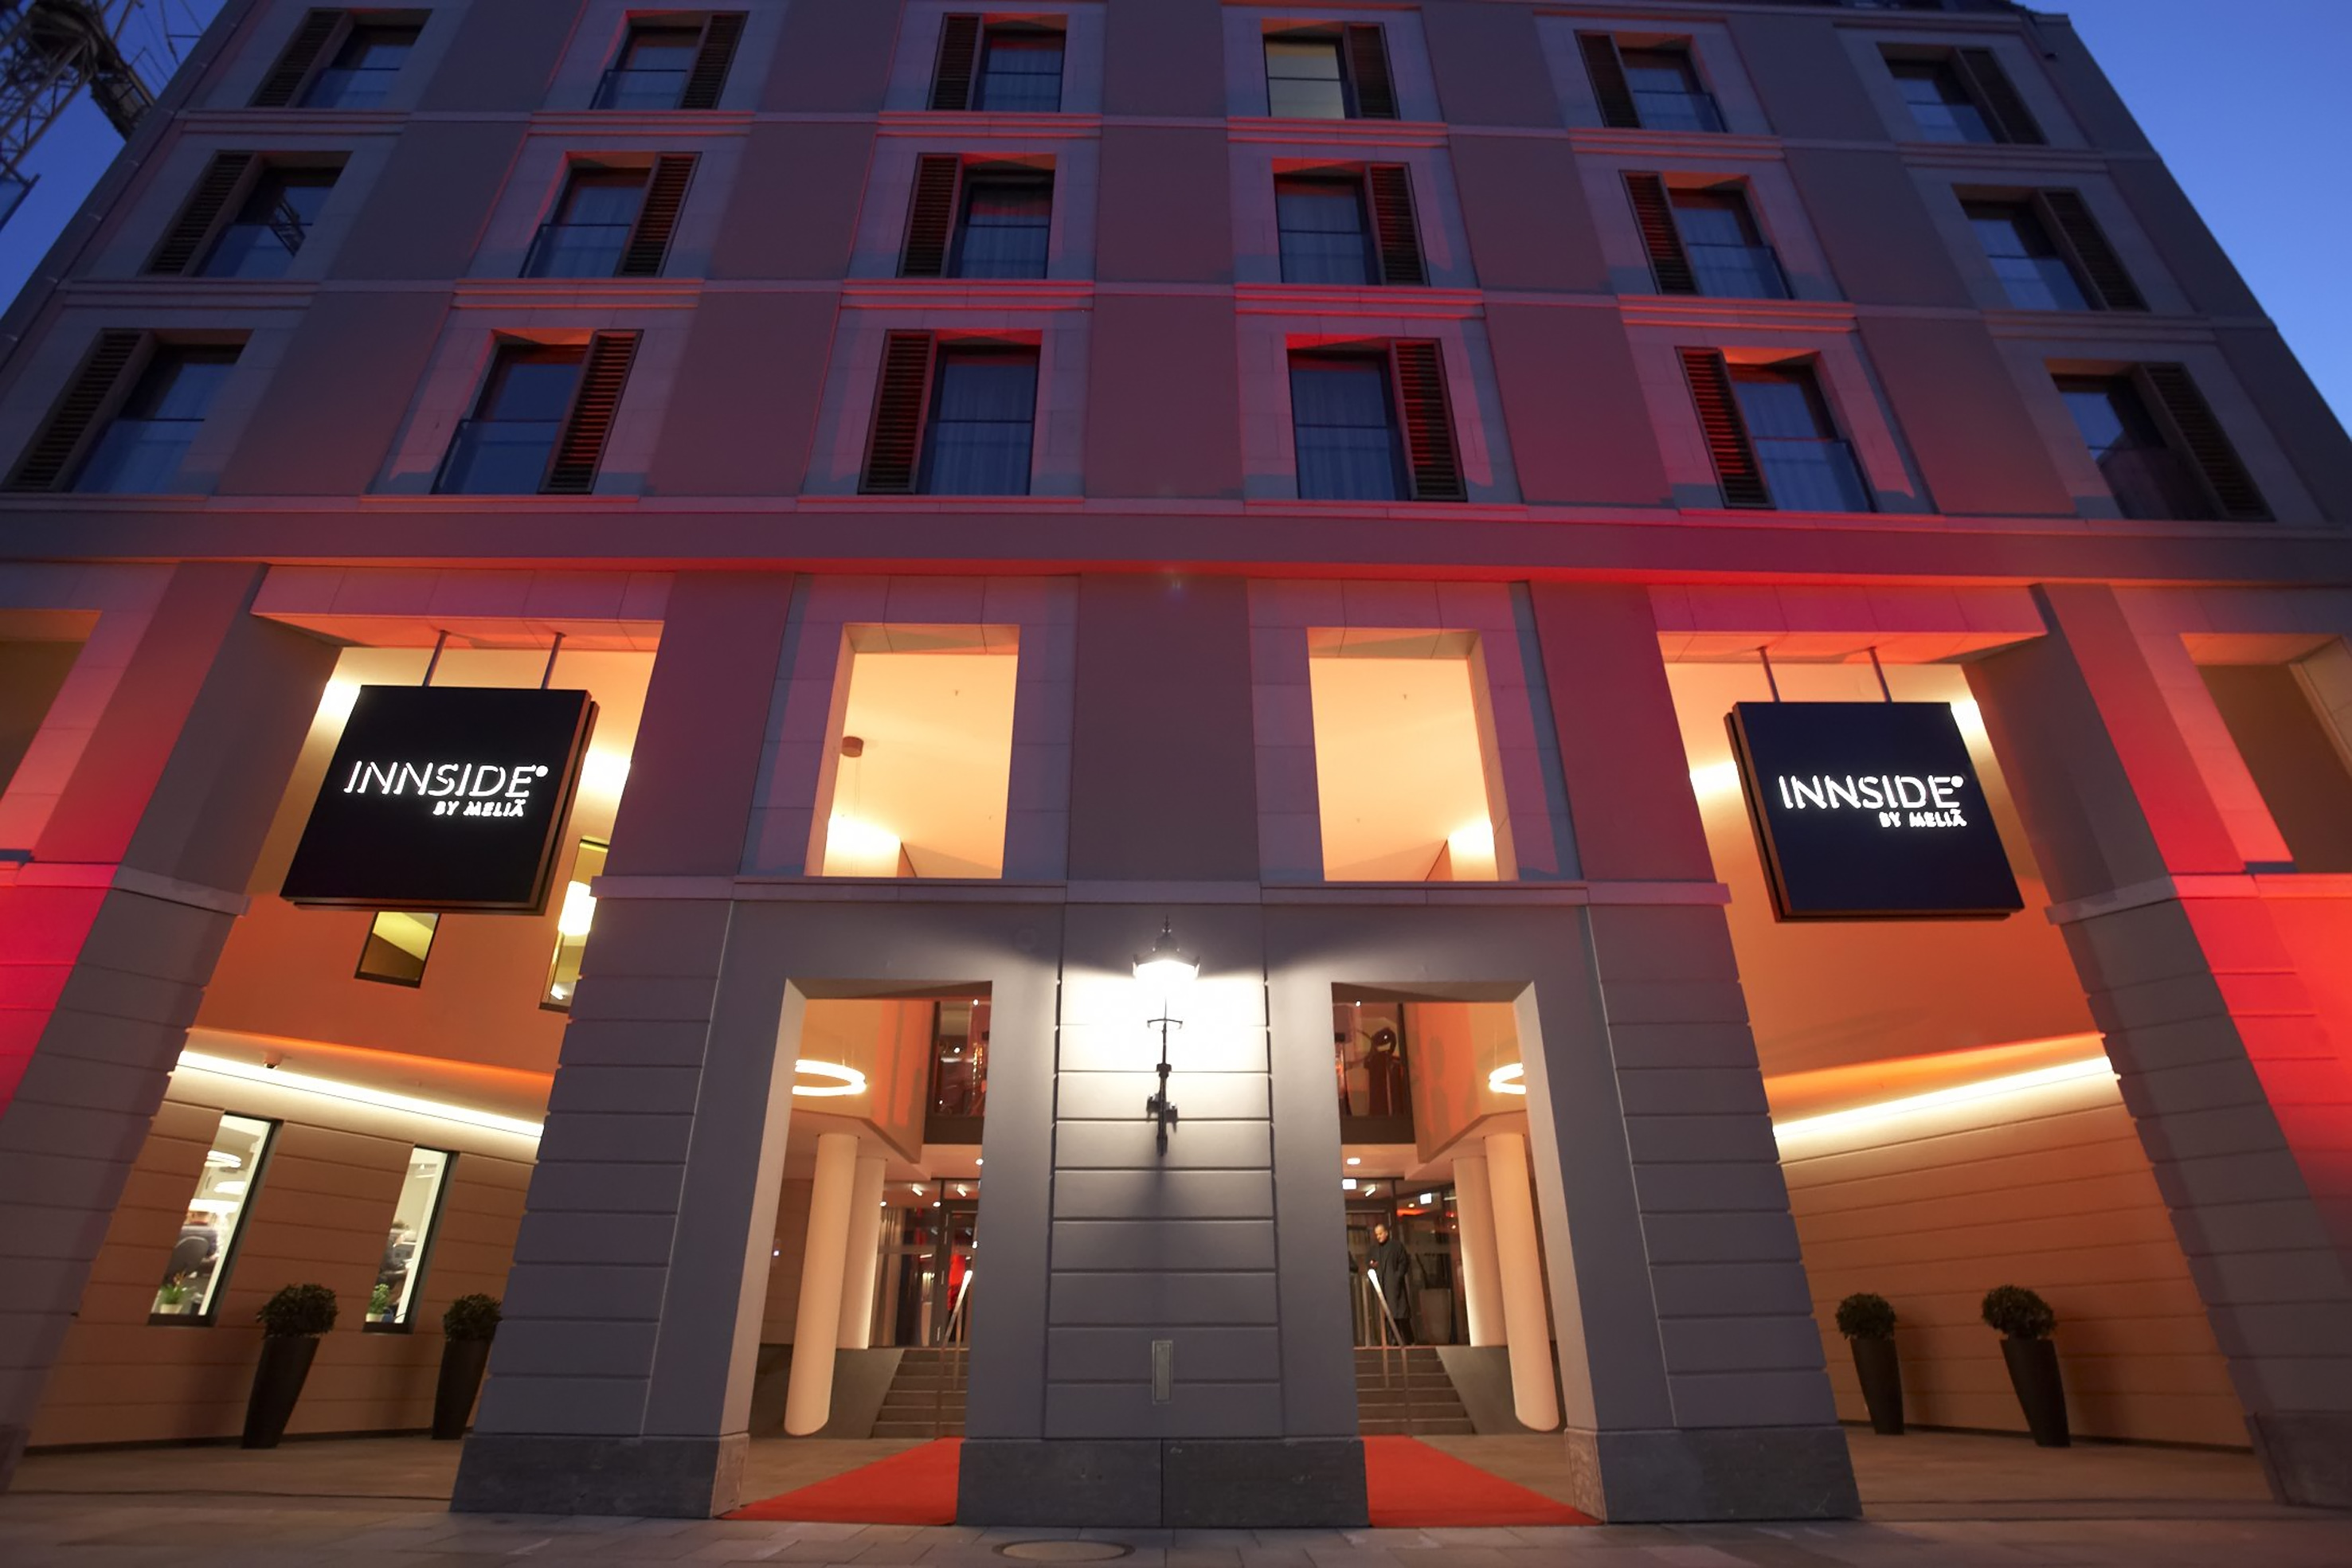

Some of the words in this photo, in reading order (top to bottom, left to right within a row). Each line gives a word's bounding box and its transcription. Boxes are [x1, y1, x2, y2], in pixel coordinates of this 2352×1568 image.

[343, 761, 538, 797] INNSIDE
[1778, 775, 1961, 810] INNSIDE
[432, 800, 460, 816] BY
[1878, 811, 1901, 827] BY
